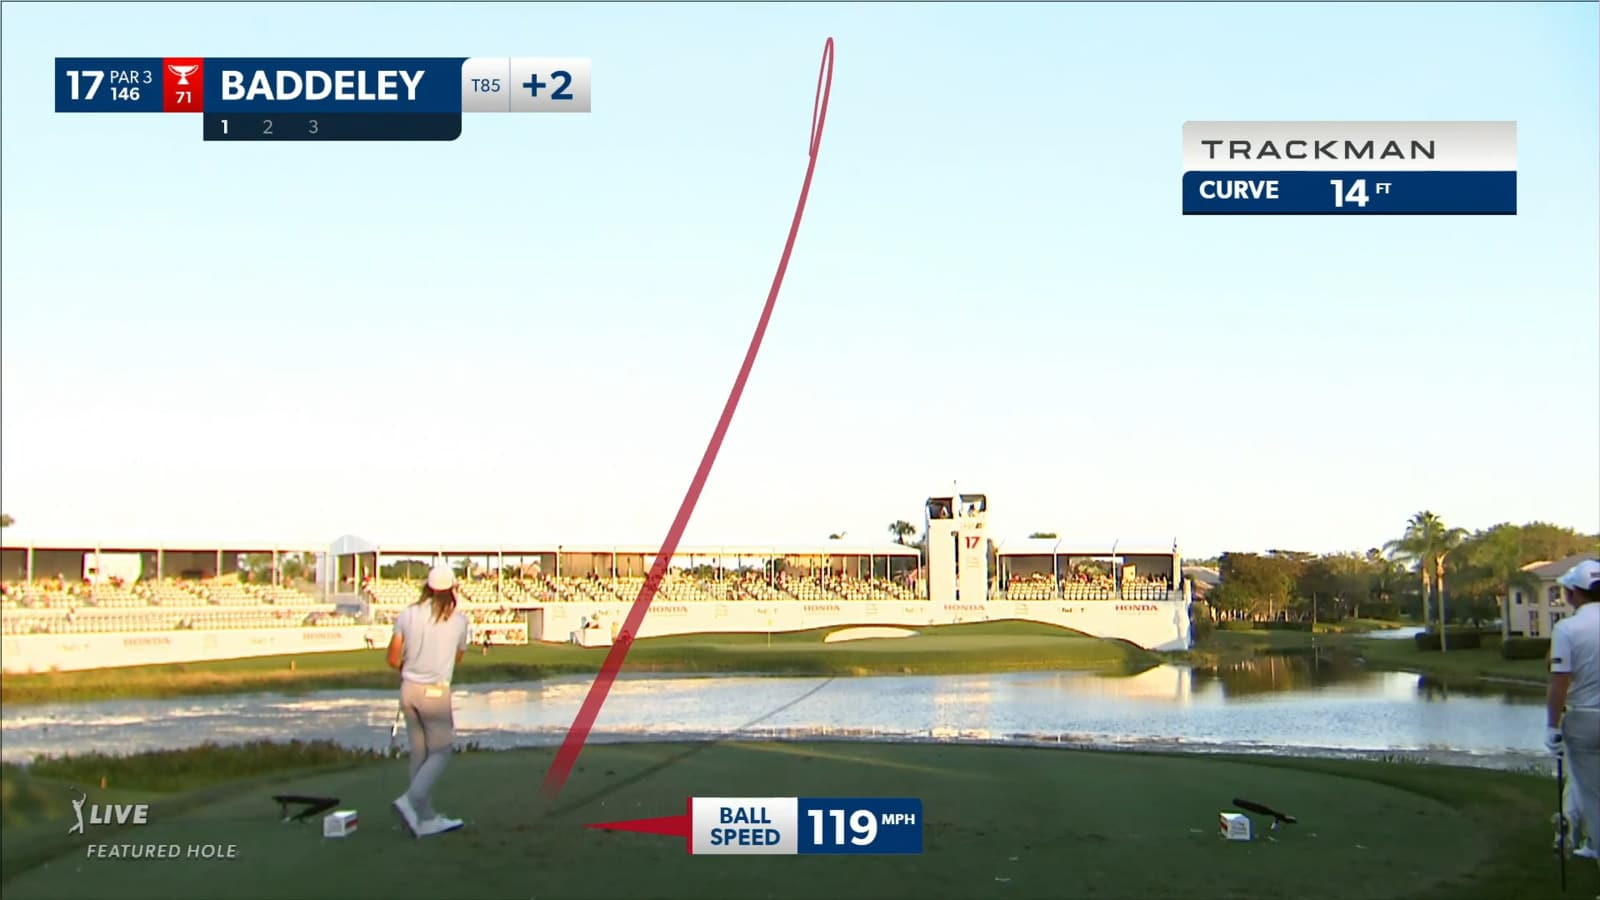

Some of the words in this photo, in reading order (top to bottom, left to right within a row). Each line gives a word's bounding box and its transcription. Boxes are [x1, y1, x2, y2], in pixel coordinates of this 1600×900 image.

[965, 536, 981, 550] 17
[803, 604, 841, 612] HONDA
[943, 603, 985, 612] HONDA
[1114, 604, 1159, 612] HONDA
